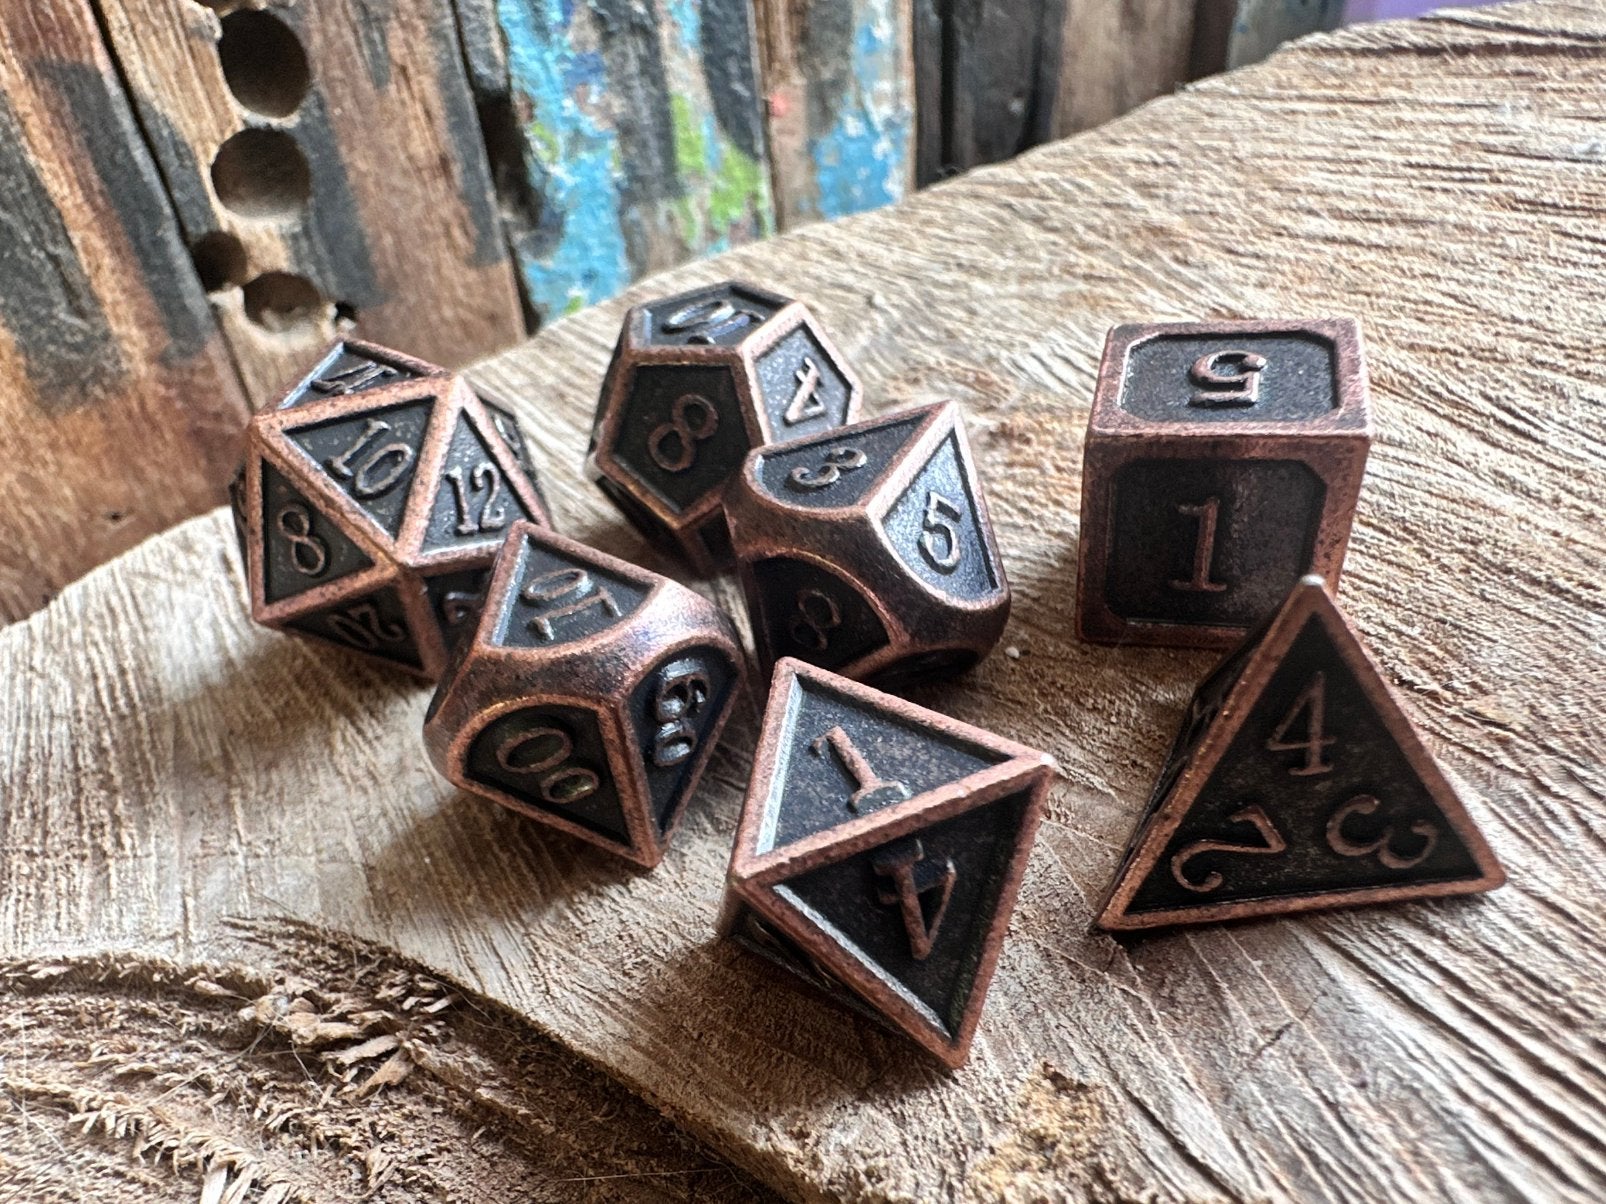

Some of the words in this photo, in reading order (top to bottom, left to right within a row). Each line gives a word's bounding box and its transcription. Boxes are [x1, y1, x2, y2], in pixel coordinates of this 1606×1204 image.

[785, 358, 823, 424] 4
[1190, 350, 1266, 406] 5
[327, 420, 414, 495] 10
[649, 395, 718, 471] 8
[789, 447, 867, 487] 3
[447, 464, 505, 534] 12
[917, 491, 962, 571] 5
[278, 505, 326, 575] 8
[1169, 498, 1226, 593] 1
[327, 604, 405, 648] 20
[522, 570, 620, 640] 10
[1268, 671, 1336, 776] 4
[497, 728, 599, 804] 00
[811, 726, 910, 811] 1
[1171, 806, 1286, 893] 2
[1327, 793, 1438, 869] 3
[873, 838, 956, 960] 4
